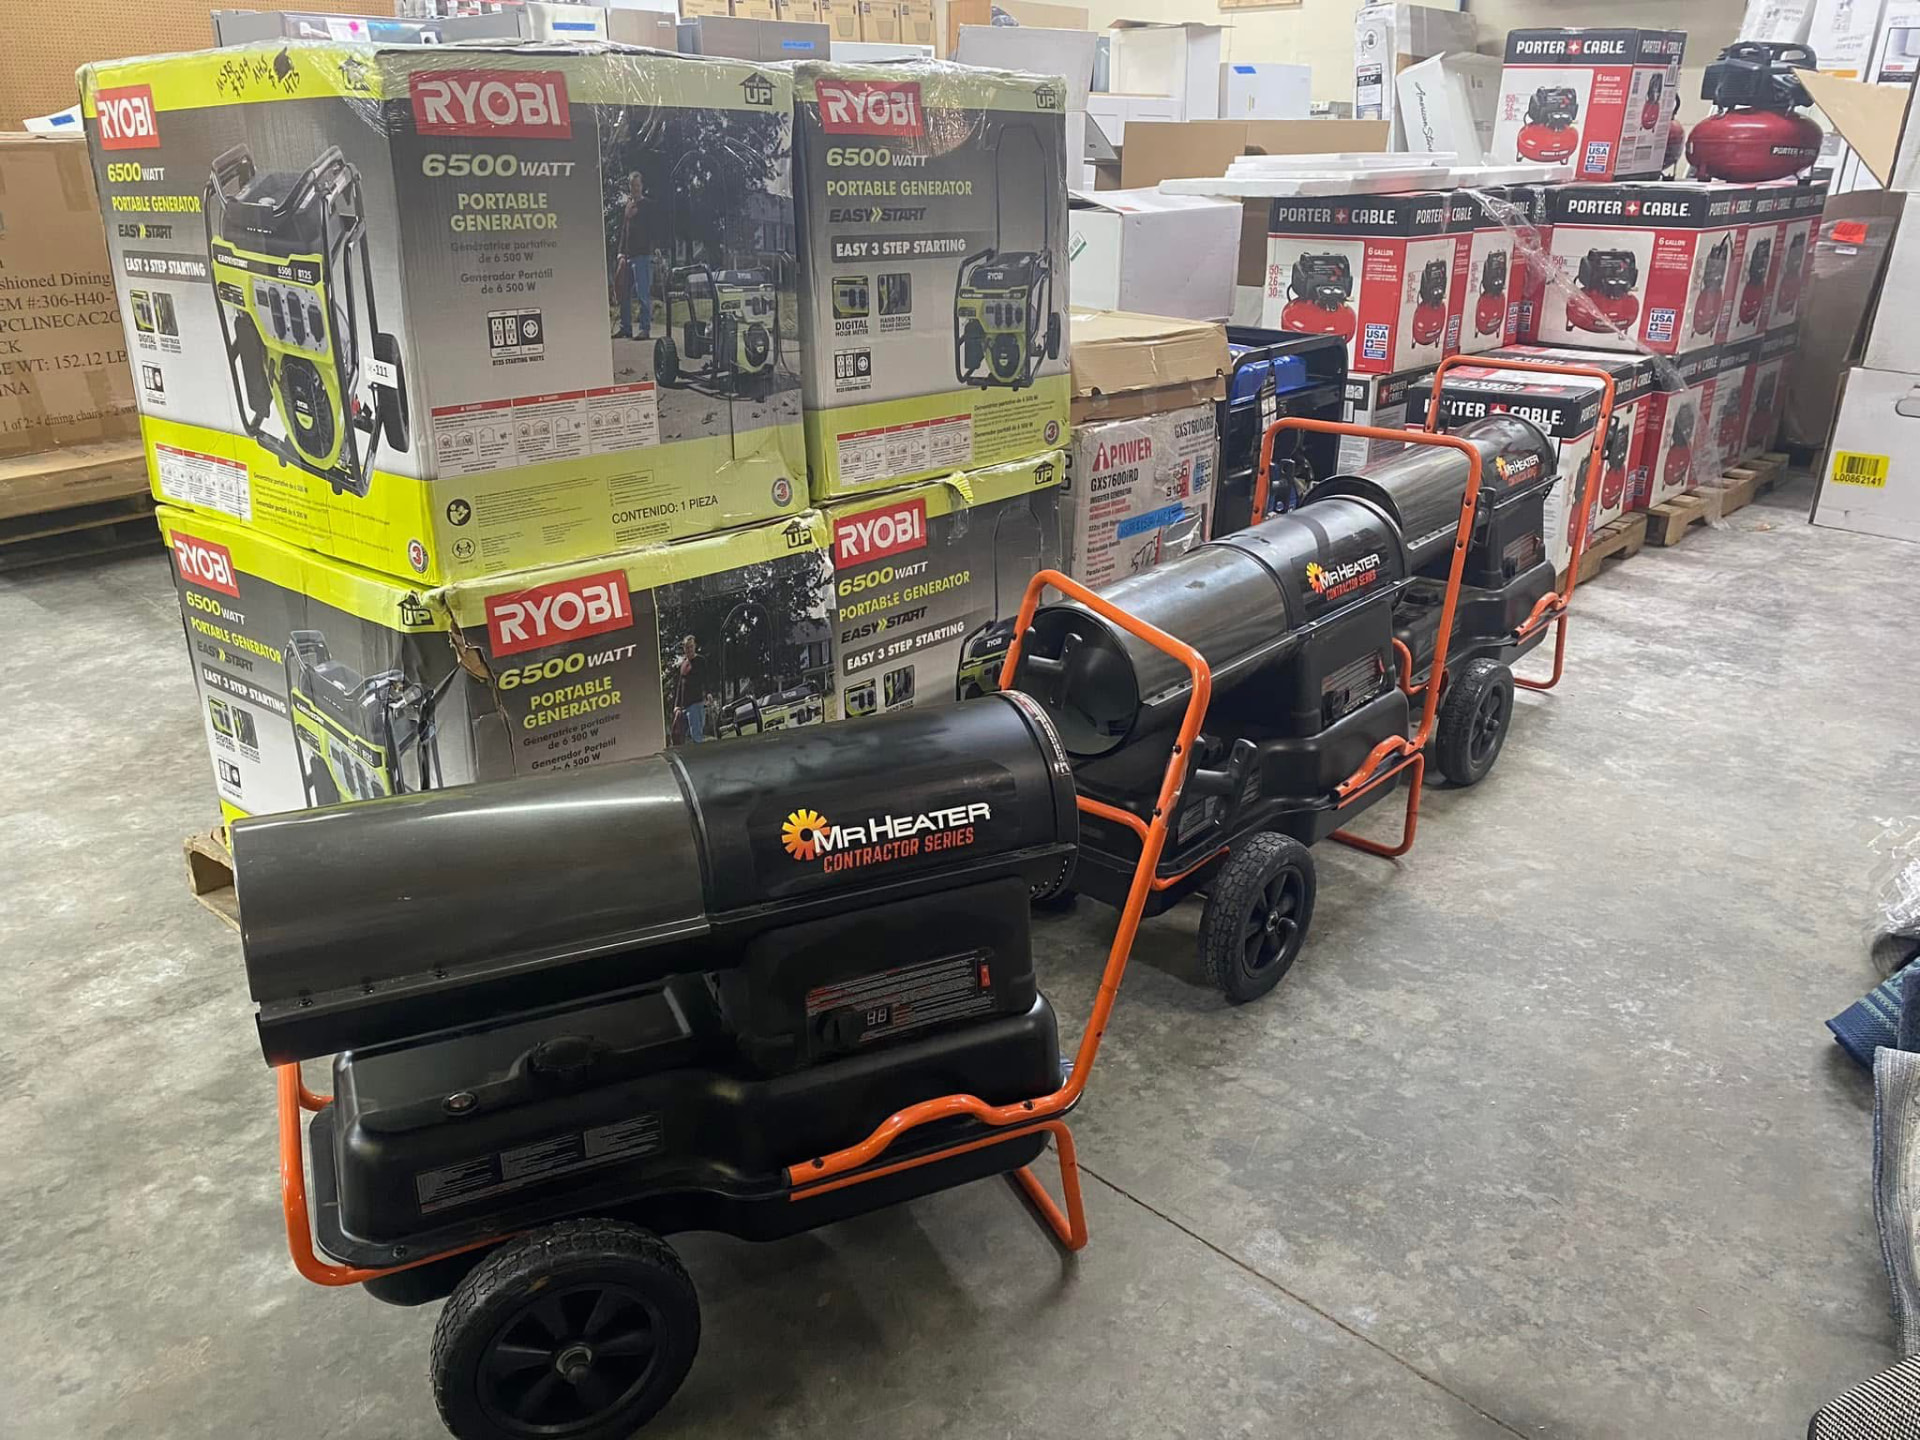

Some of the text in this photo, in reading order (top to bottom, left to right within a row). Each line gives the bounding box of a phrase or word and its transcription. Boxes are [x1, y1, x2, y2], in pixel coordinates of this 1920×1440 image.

[1516, 40, 1626, 54] PORTER CABLE
[416, 80, 561, 127] RYOBI
[746, 87, 771, 104] UP
[822, 88, 917, 126] RYOBI
[97, 95, 155, 139] RYOBI
[826, 147, 928, 168] 6500 WATT
[1589, 147, 1607, 155] USA
[107, 164, 165, 183] 6500 WATT
[421, 154, 575, 178] 6500 WATT
[826, 180, 973, 196] PORTABLE GENERATOR
[112, 196, 201, 213] PORTABLE GENERATOR
[457, 193, 548, 210] PORTABLE
[1567, 200, 1691, 217] PORTER CABLE
[1709, 203, 1730, 216] PORTER
[450, 213, 558, 232] GENERATOR
[828, 207, 927, 223] EASY START
[1279, 207, 1397, 225] PORTER CABLE
[1415, 206, 1473, 224] PORTER CABLE
[118, 224, 173, 239] EASY START
[836, 238, 967, 257] EASY 3 STEP STARTING
[1658, 237, 1665, 246] 6
[478, 251, 534, 263] de 6 500 W
[1367, 247, 1394, 257] 6 GALLON
[125, 257, 206, 277] EASY 3 STEP STARTING
[61, 271, 112, 288] Dining
[481, 281, 537, 295] de 6 500 W
[835, 319, 869, 331] DIGITAL
[1651, 314, 1672, 322] USA
[1366, 330, 1387, 339] USA
[17, 352, 103, 373] WT: 152.12
[1637, 372, 1652, 388] CABLE
[44, 412, 76, 426] dining
[1048, 424, 1056, 439] 3
[1514, 454, 1540, 472] HEATER
[1036, 471, 1053, 484] UP
[1833, 473, 1882, 486] L00862141
[777, 484, 788, 500] 3
[612, 494, 719, 524] CONTENIDO: 1 PIEZA
[788, 528, 812, 547] UP
[838, 508, 921, 559] RYOBI
[173, 540, 234, 587] RYOBI
[412, 546, 423, 565] 3
[1339, 553, 1381, 579] HEATER
[838, 561, 928, 597] 6500 WATT
[1325, 569, 1377, 601] CONTRACTOR SERIES
[839, 570, 970, 622] PORTABLE GENERATOR
[186, 591, 246, 625] 6500 WATT
[402, 609, 431, 625] UP
[493, 581, 624, 645] RYOBI
[841, 606, 928, 644] EASY START
[191, 617, 283, 665] PORTABLE GENERATOR
[847, 621, 965, 671] EASY 3 STEP STARTING
[197, 641, 254, 673] EASY START
[498, 643, 638, 691] 6500 WATT
[203, 668, 223, 685] EASY
[223, 677, 230, 689] 3
[230, 680, 248, 697] STEP
[249, 687, 287, 714] STARTING
[530, 675, 613, 711] PORTABLE
[522, 691, 622, 730] GENERATOR
[548, 740, 560, 750] de
[571, 731, 588, 743] 500
[589, 728, 600, 738] W
[531, 750, 582, 770] Generador
[591, 752, 601, 762] W
[868, 802, 991, 842] HEATER
[823, 827, 975, 874] CONTRACTOR SERIES
